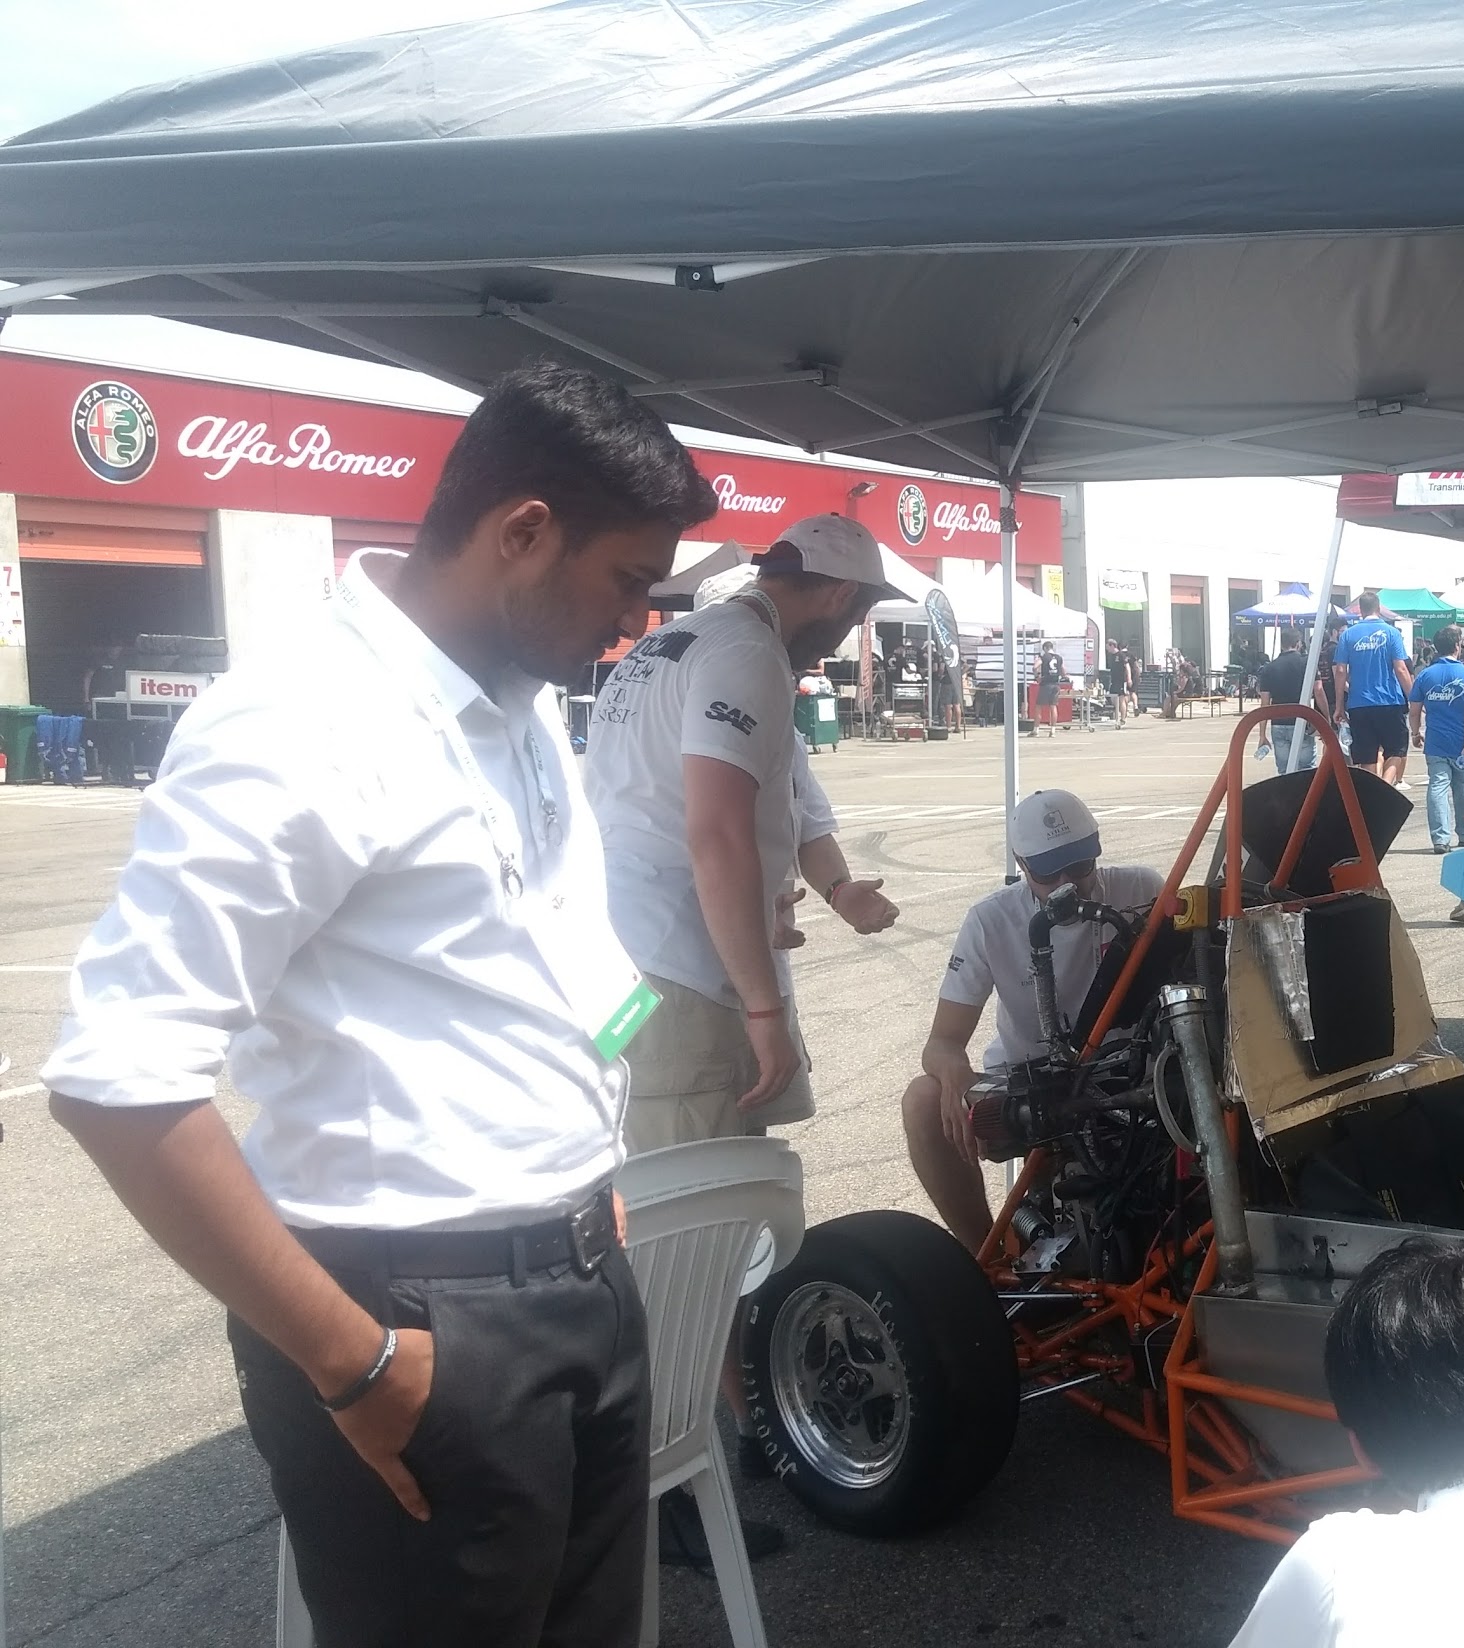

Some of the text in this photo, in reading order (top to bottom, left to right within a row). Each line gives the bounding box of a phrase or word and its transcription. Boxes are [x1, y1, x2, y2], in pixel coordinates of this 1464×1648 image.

[76, 386, 156, 438] ALFA ROMEO
[177, 415, 416, 481] Alfa Romeo
[712, 474, 786, 514] Romeo
[933, 501, 1022, 541] Alfa Rom
[1416, 612, 1453, 620] www.pb.edu.pl
[140, 677, 197, 698] item
[704, 700, 758, 736] SAE
